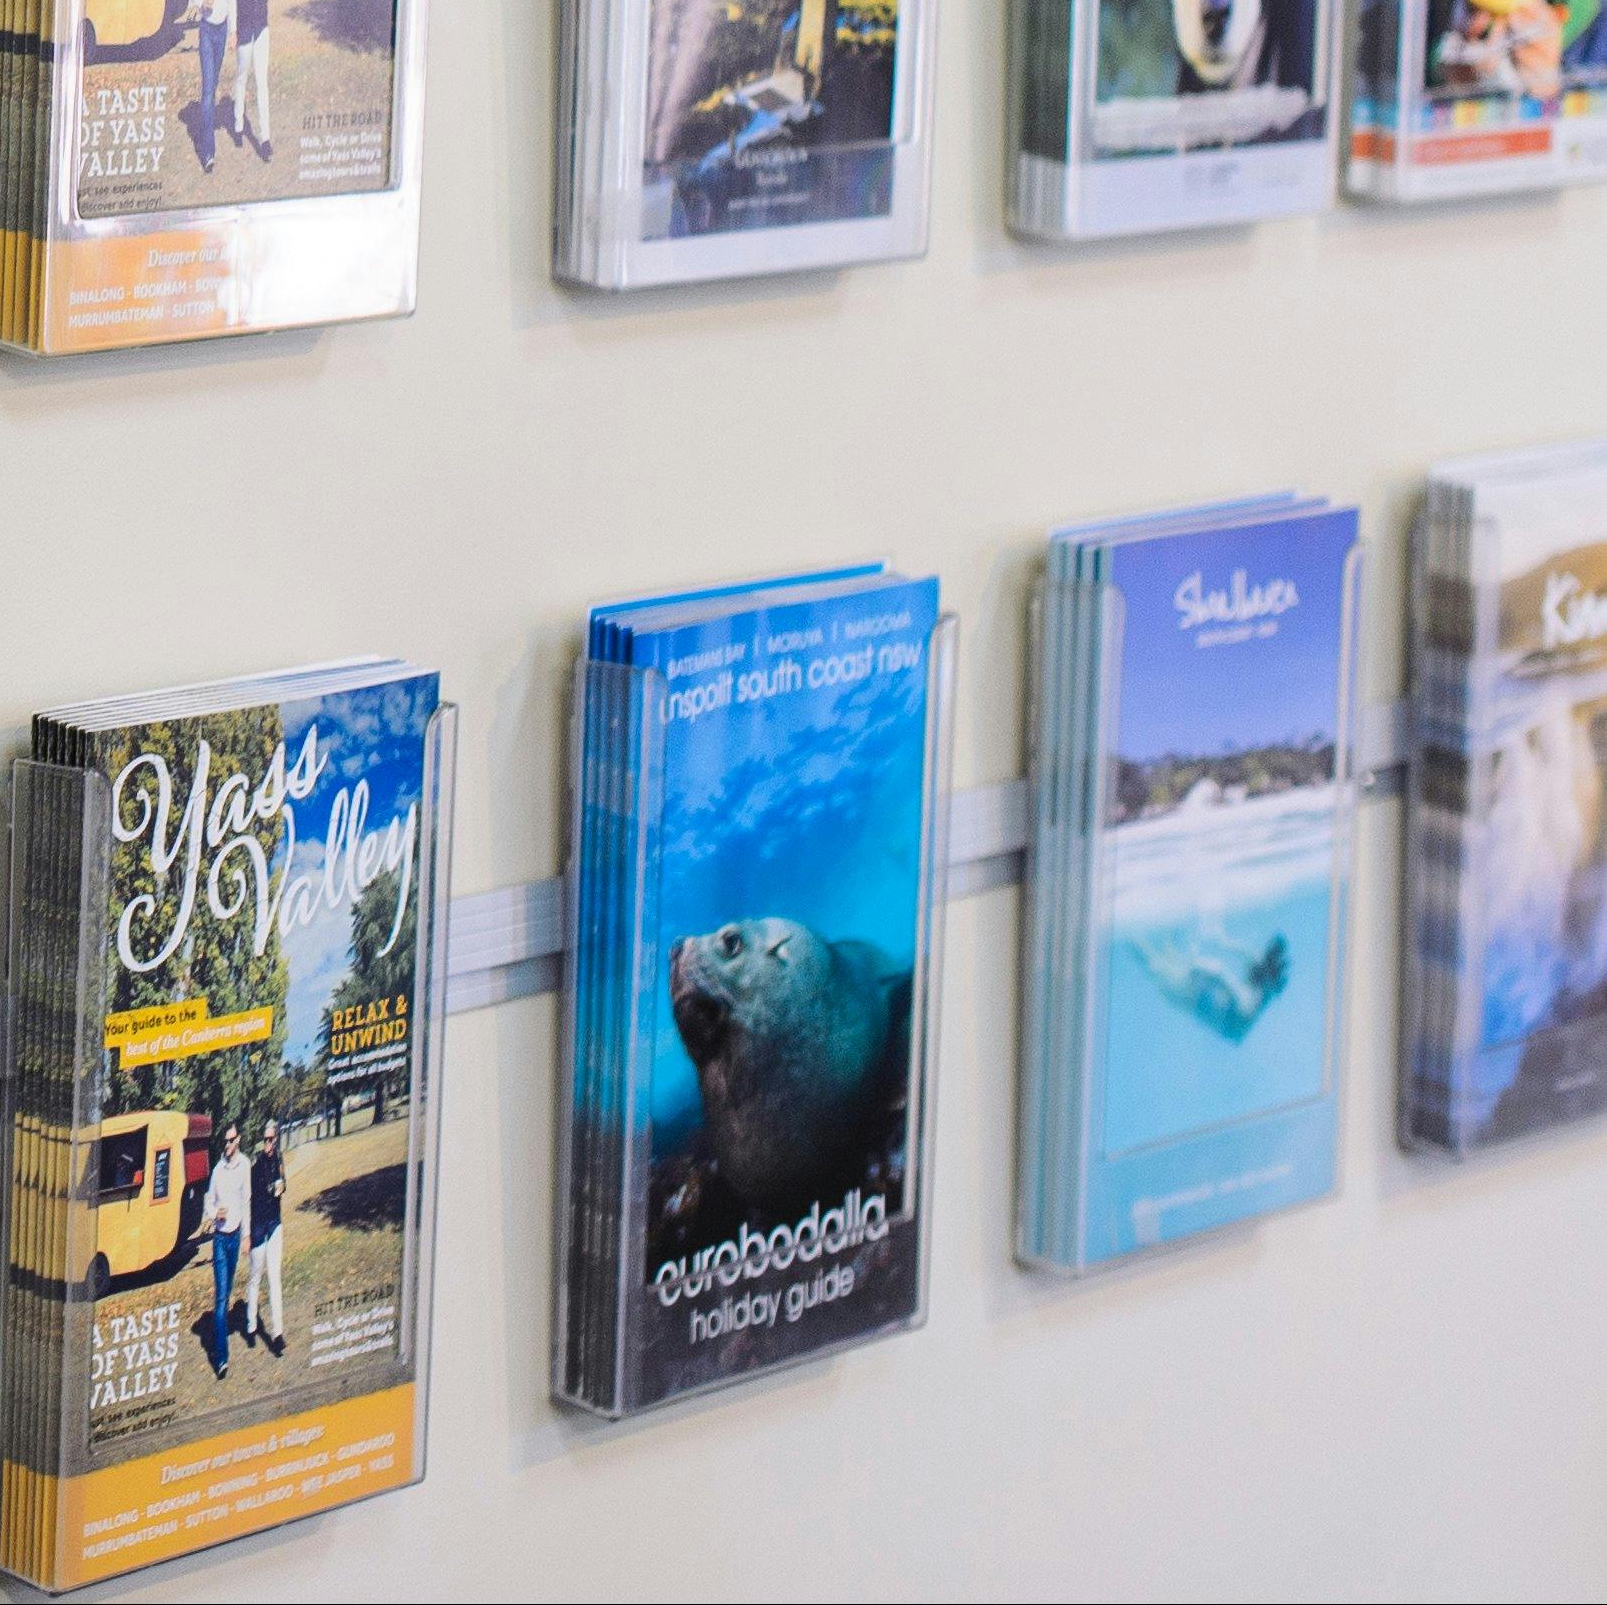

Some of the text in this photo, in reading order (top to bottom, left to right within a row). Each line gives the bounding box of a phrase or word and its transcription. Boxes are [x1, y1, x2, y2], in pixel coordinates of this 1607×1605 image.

[97, 85, 168, 116] TASTE
[109, 115, 166, 145] YASS
[737, 657, 802, 703] south
[808, 645, 874, 689] coast
[111, 723, 329, 973] Yass
[207, 778, 418, 958] Valley
[331, 994, 408, 1032] RELAX &
[331, 1018, 407, 1056] UNWIND
[653, 1187, 890, 1307] eurobodalla
[110, 1302, 183, 1344] TASTE
[689, 1262, 856, 1346] holiday guide
[123, 1332, 180, 1371] YASS
